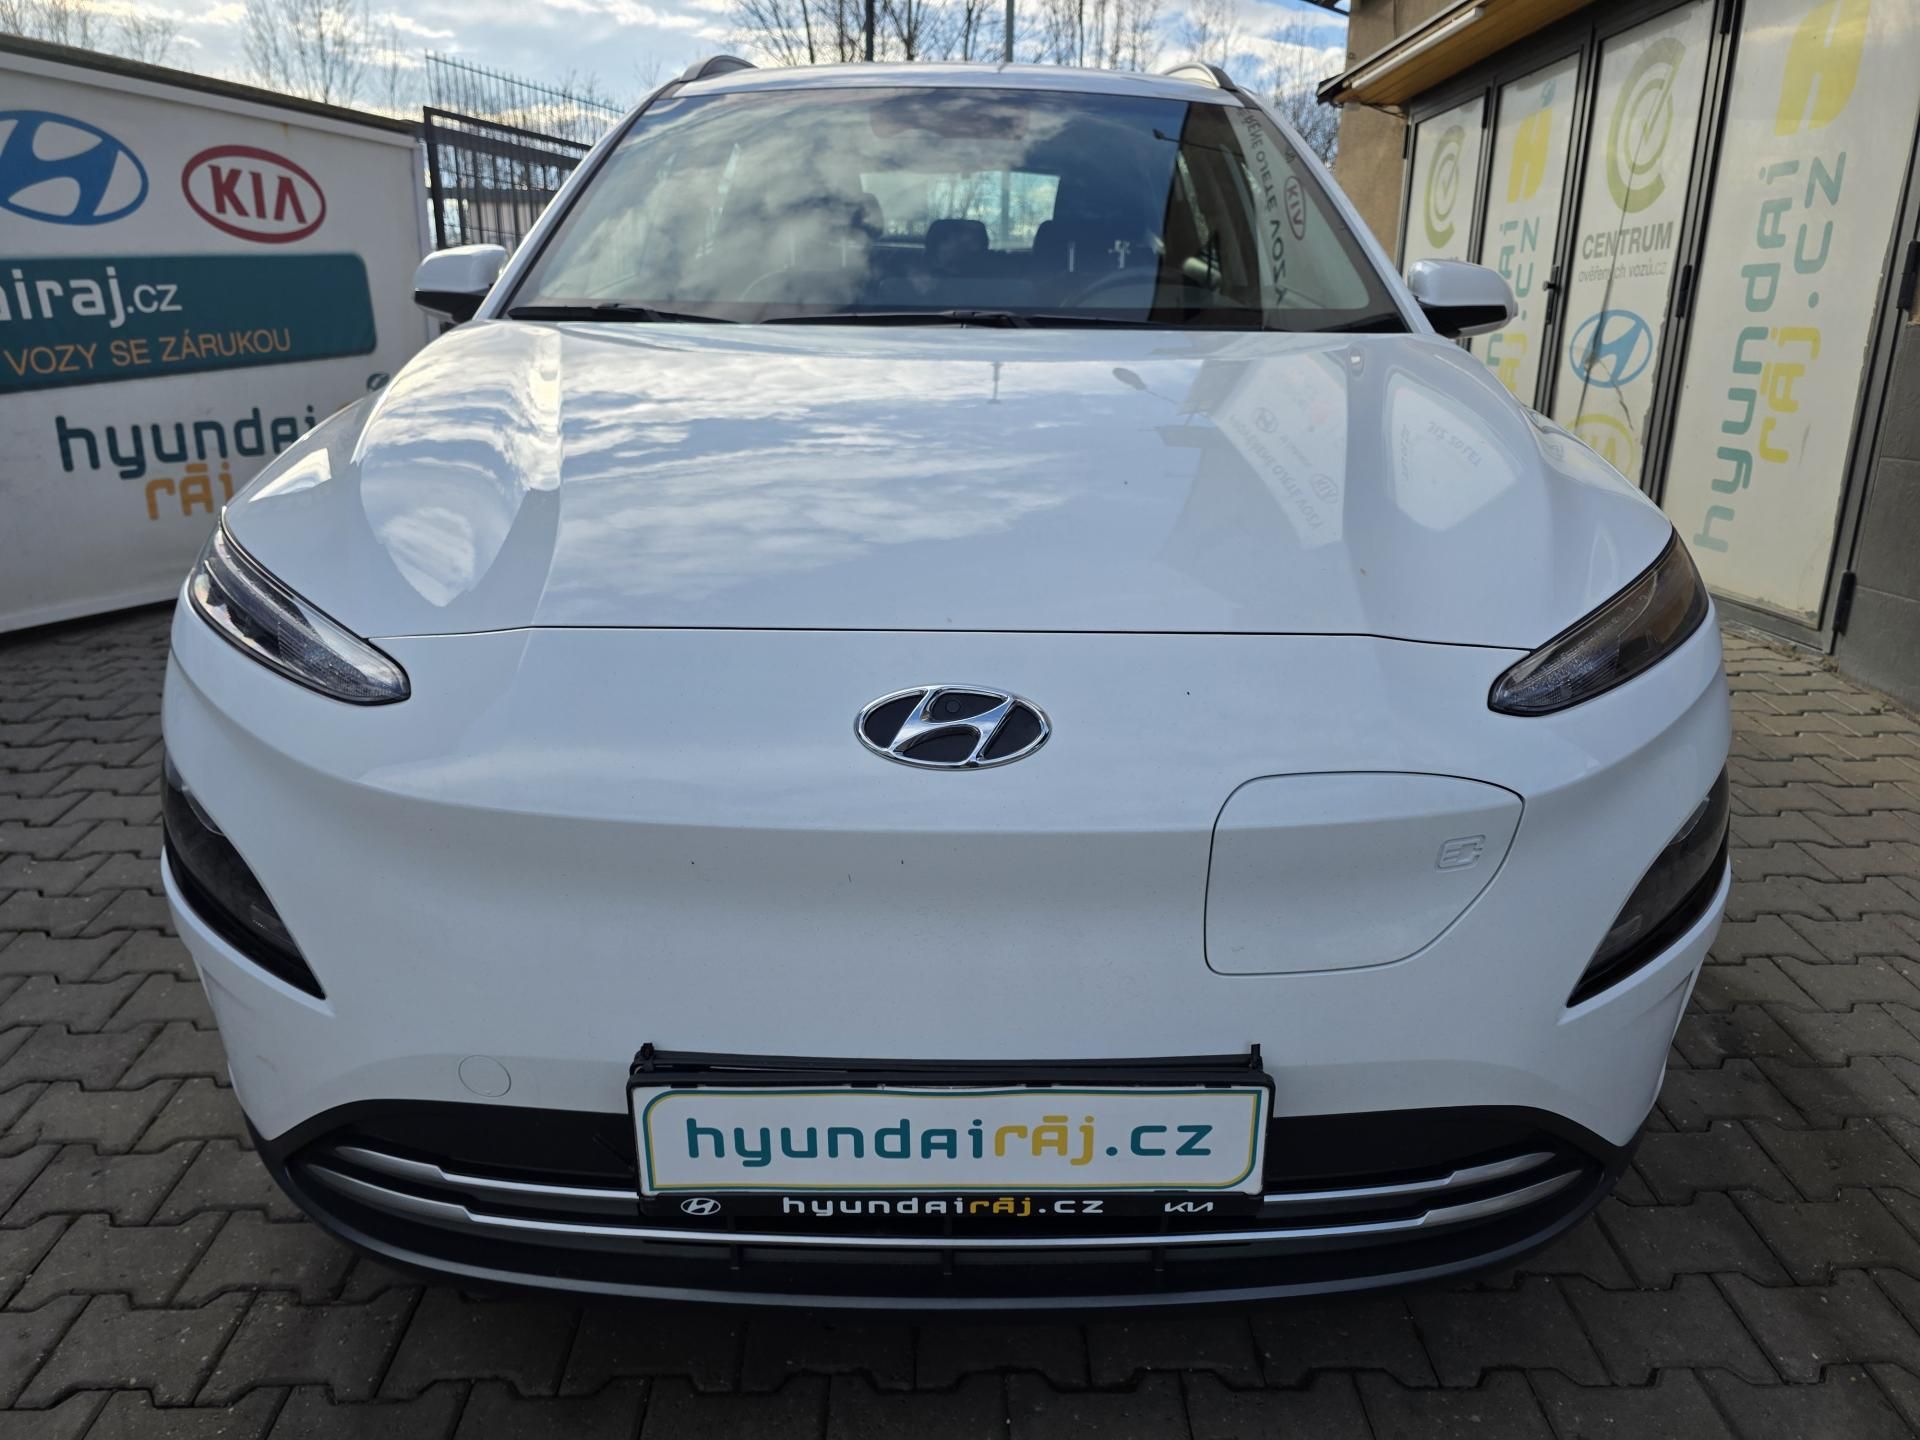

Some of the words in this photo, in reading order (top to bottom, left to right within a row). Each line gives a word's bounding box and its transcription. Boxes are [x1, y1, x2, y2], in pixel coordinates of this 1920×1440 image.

[208, 164, 307, 224] KIA
[1582, 221, 1674, 260] CENTRUM
[4, 343, 98, 377] VOZY
[110, 338, 151, 367] SE
[158, 328, 292, 362] ZÁRUKOU
